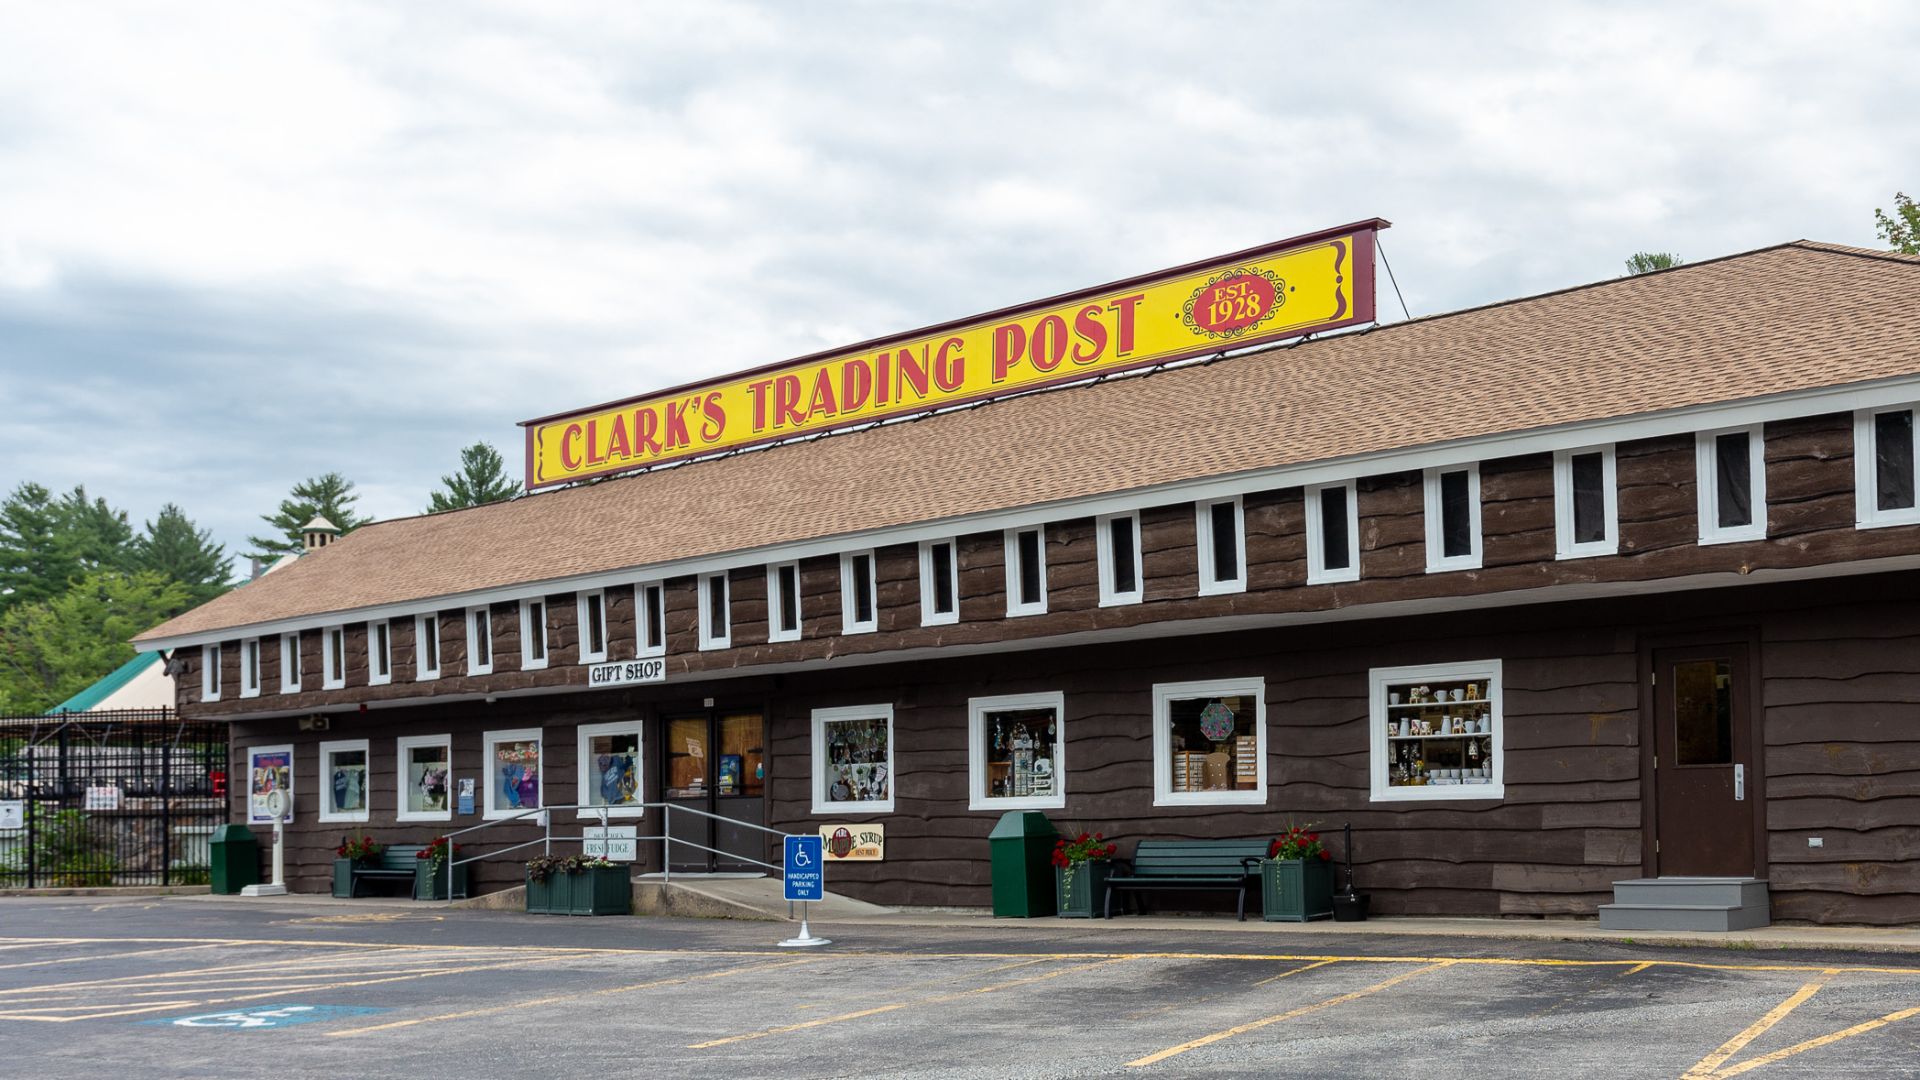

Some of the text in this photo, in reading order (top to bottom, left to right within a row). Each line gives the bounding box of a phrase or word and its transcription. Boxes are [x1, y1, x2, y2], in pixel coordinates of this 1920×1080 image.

[1214, 281, 1254, 302] EST.
[1208, 294, 1261, 326] 1928
[560, 294, 1145, 471] CLARK'S TRADING POST
[592, 661, 662, 682] GIFT SHOP
[860, 831, 883, 846] SYRUP
[787, 872, 820, 880] HANDICAPPED
[792, 880, 815, 888] PARKING
